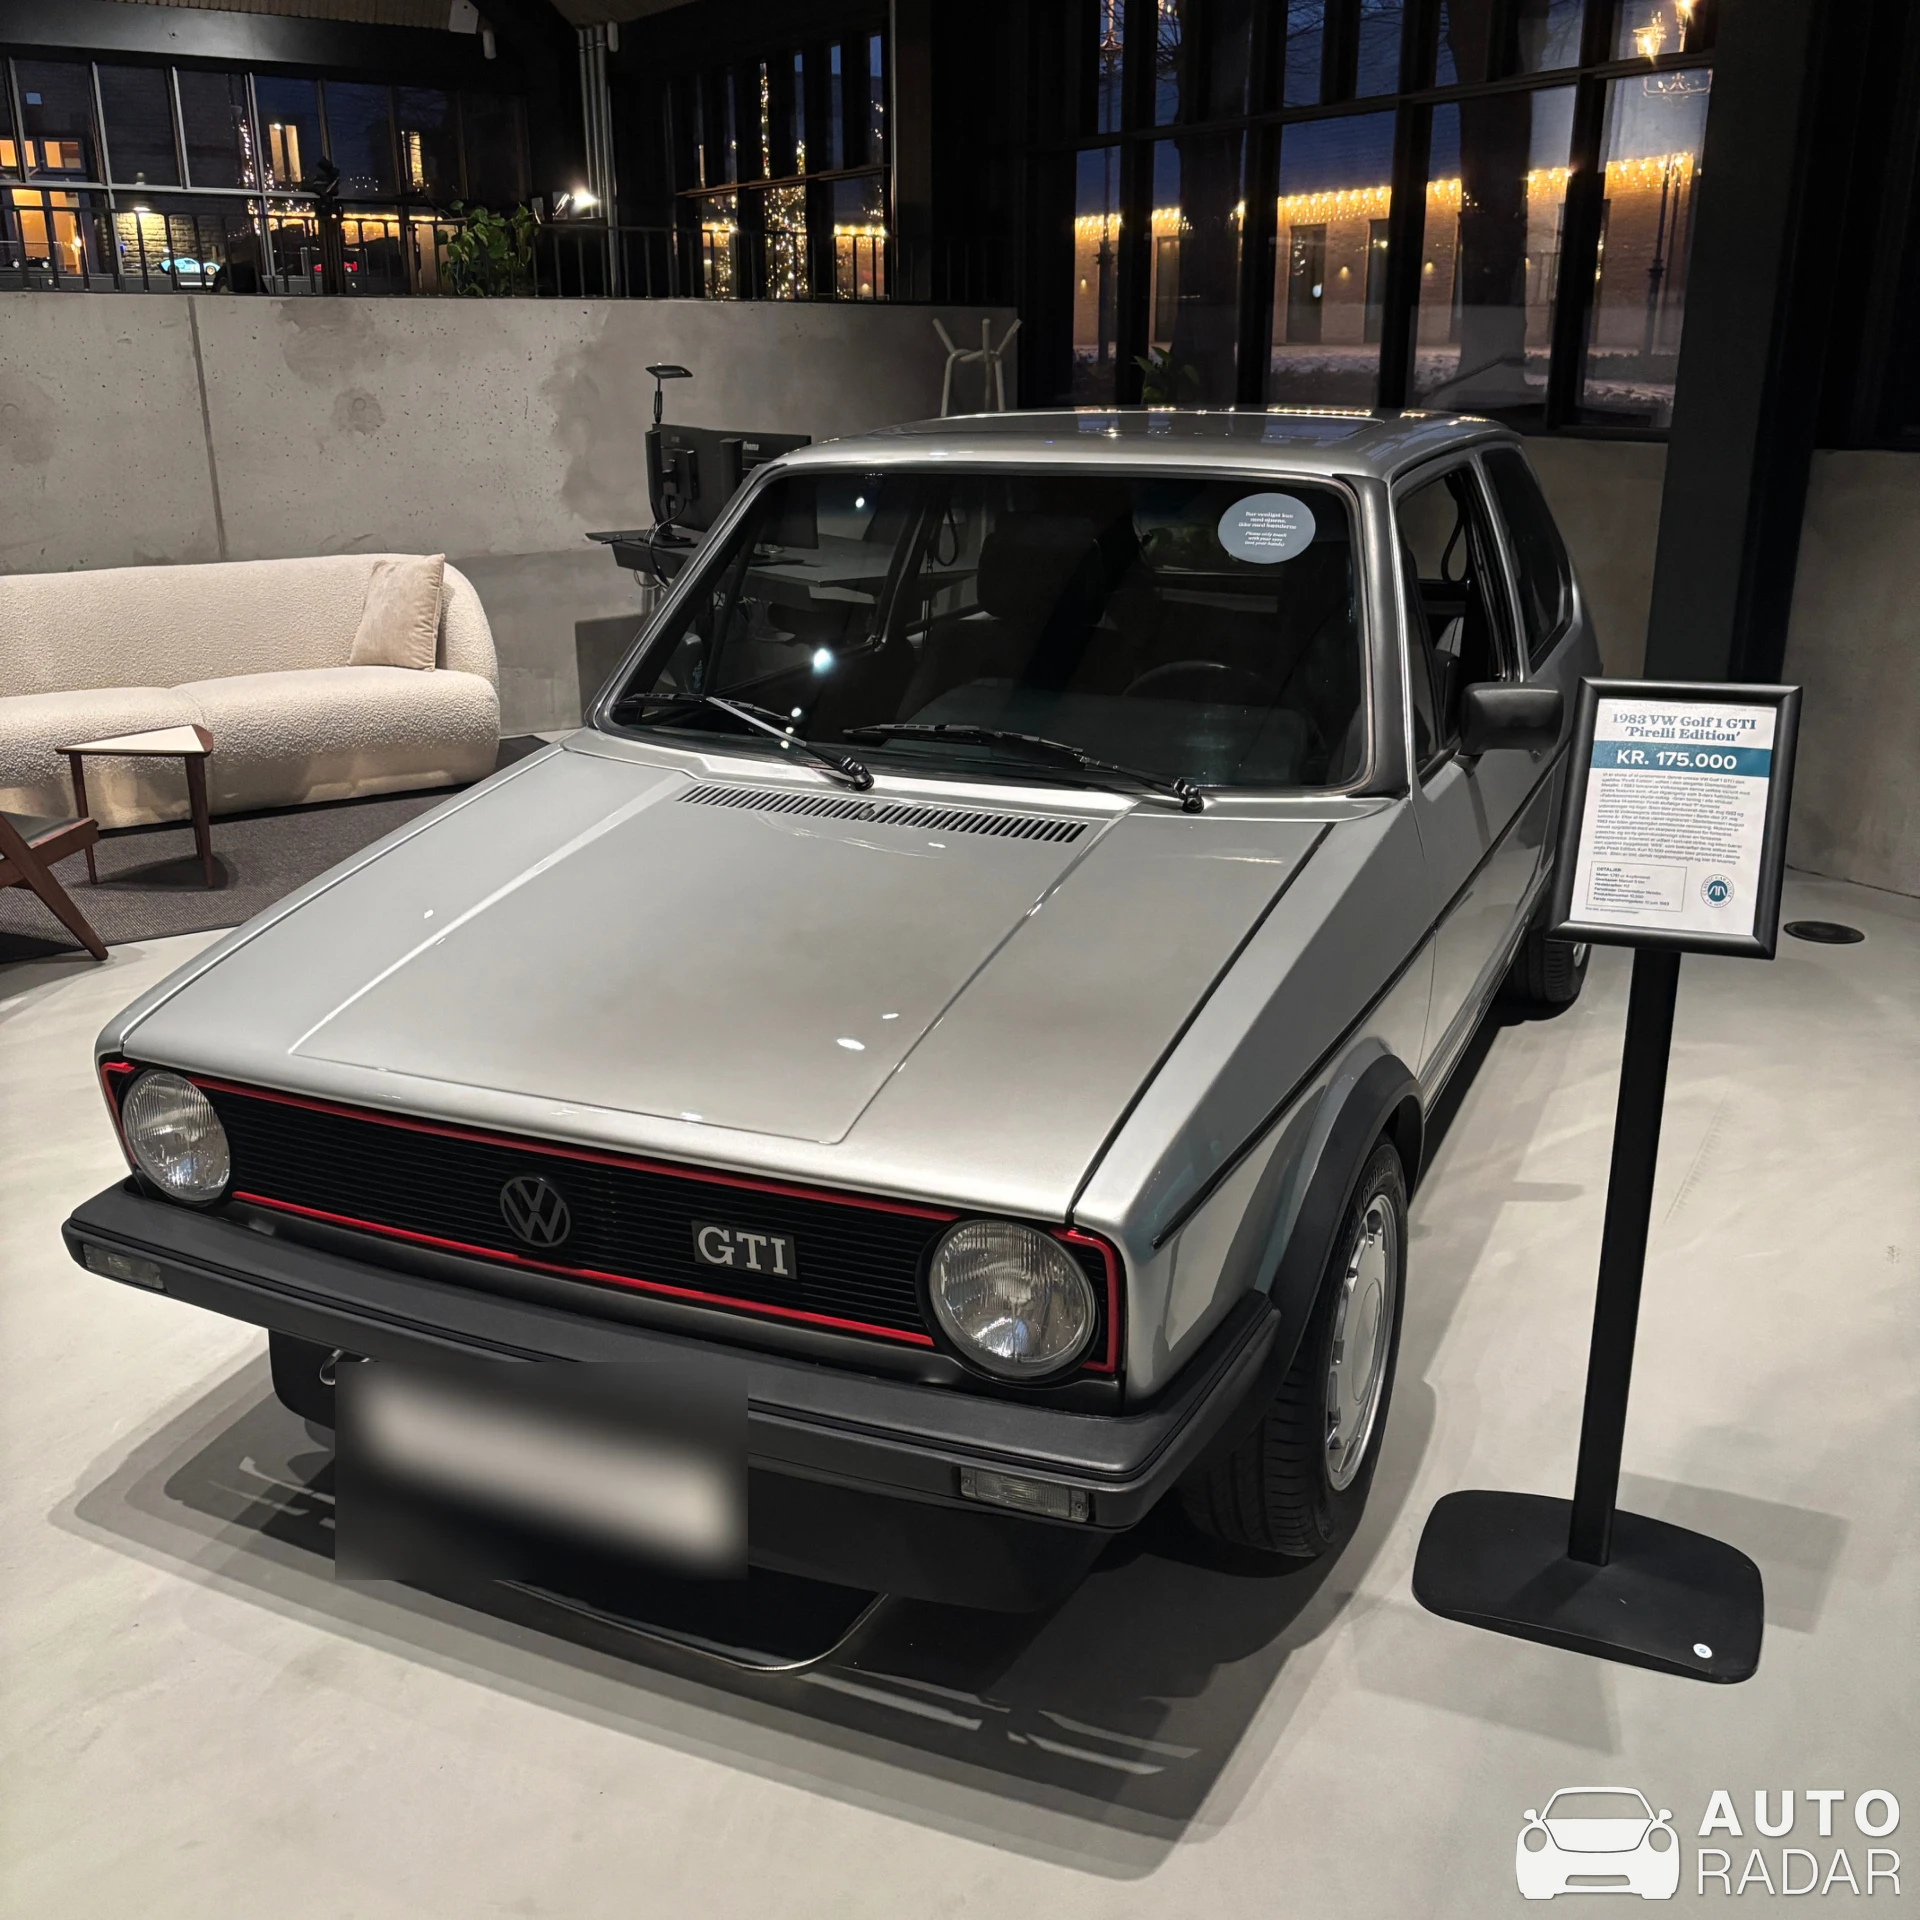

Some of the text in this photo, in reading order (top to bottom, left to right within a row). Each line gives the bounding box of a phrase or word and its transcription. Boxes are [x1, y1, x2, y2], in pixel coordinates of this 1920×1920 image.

[1613, 714, 1756, 730] 1983 VW Golf 1 GTI
[1625, 726, 1740, 741] 'Pirelli Edition'
[1616, 750, 1737, 770] KR. 175.000
[500, 1176, 571, 1248] VW
[697, 1226, 788, 1276] GTI
